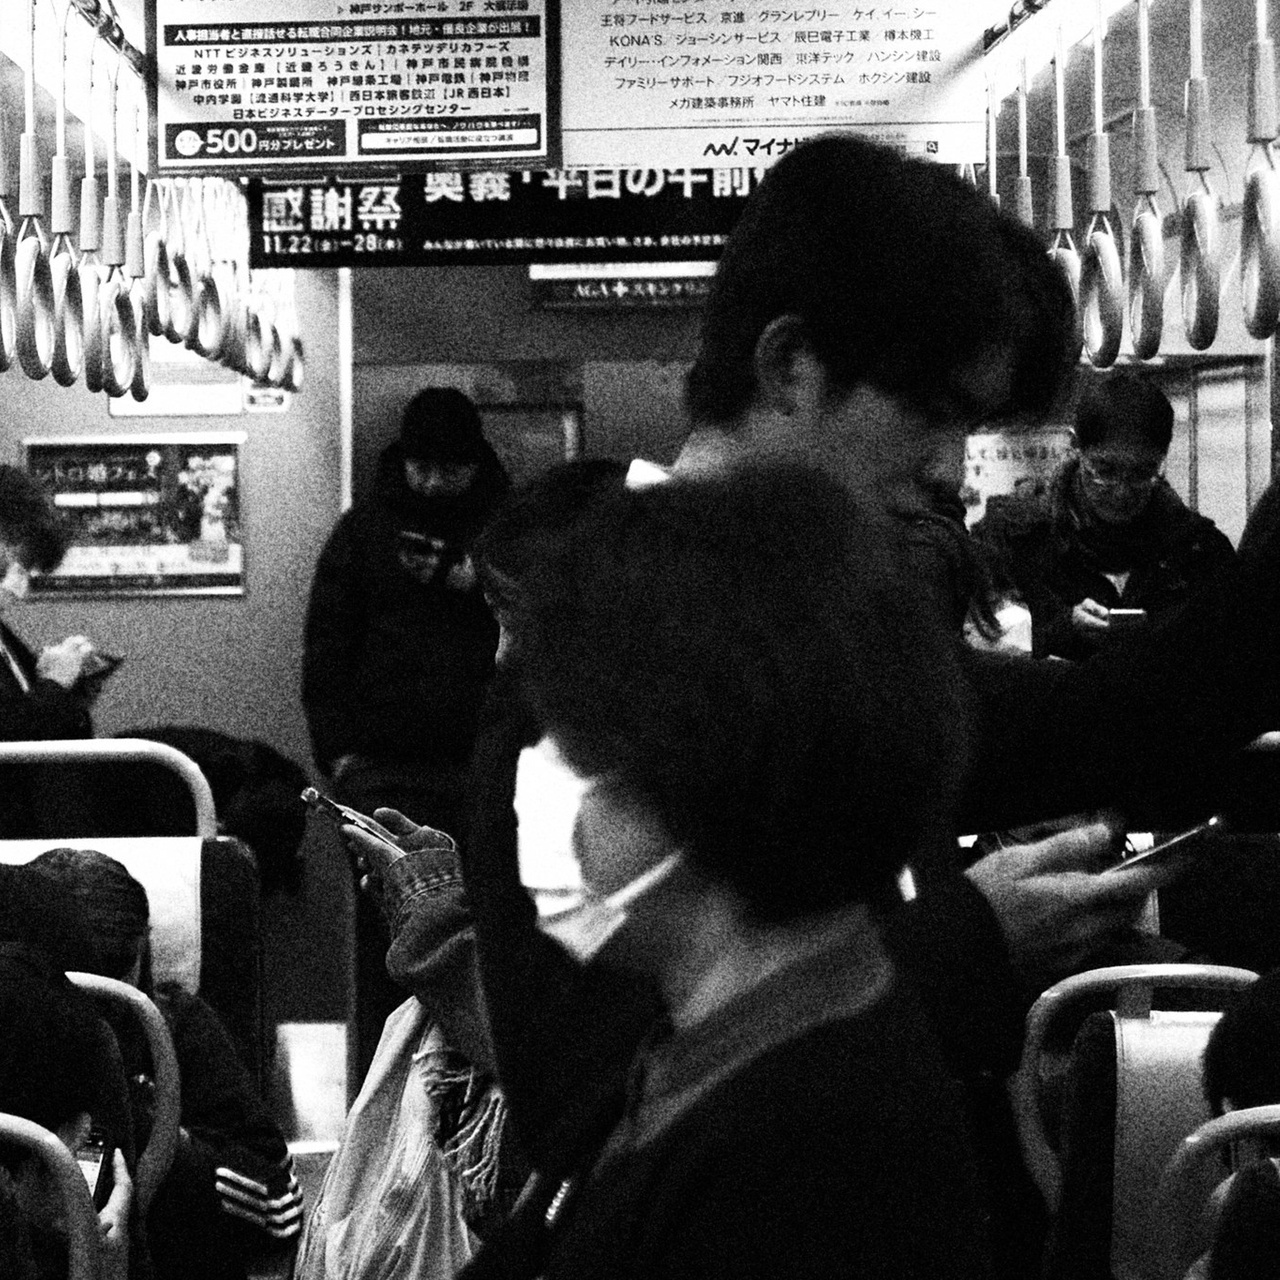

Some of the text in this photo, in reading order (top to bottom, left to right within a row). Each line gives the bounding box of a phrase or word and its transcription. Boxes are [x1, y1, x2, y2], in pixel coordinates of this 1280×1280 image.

[458, 1, 474, 12] 2F
[600, 11, 708, 27] 王将フードサービス
[720, 11, 746, 24] 京進
[675, 31, 782, 45] ジョーシンサービス
[386, 41, 510, 55] カネテツデリカフーズ
[796, 51, 855, 65] 東洋テック
[866, 50, 942, 63] ハンシン建設
[175, 77, 237, 91] 神戸市役所
[415, 72, 466, 85] 神戸電鉄
[479, 71, 530, 83] 神戸物産
[615, 71, 932, 90] ファミリーサポート フジオフードシステム ホクシン建設
[193, 93, 242, 106] 中内学園
[768, 94, 827, 108] ヤマト住建
[232, 103, 472, 120] 日本ビジネスデータープロセシングセンター
[262, 186, 402, 232] 感謝祭
